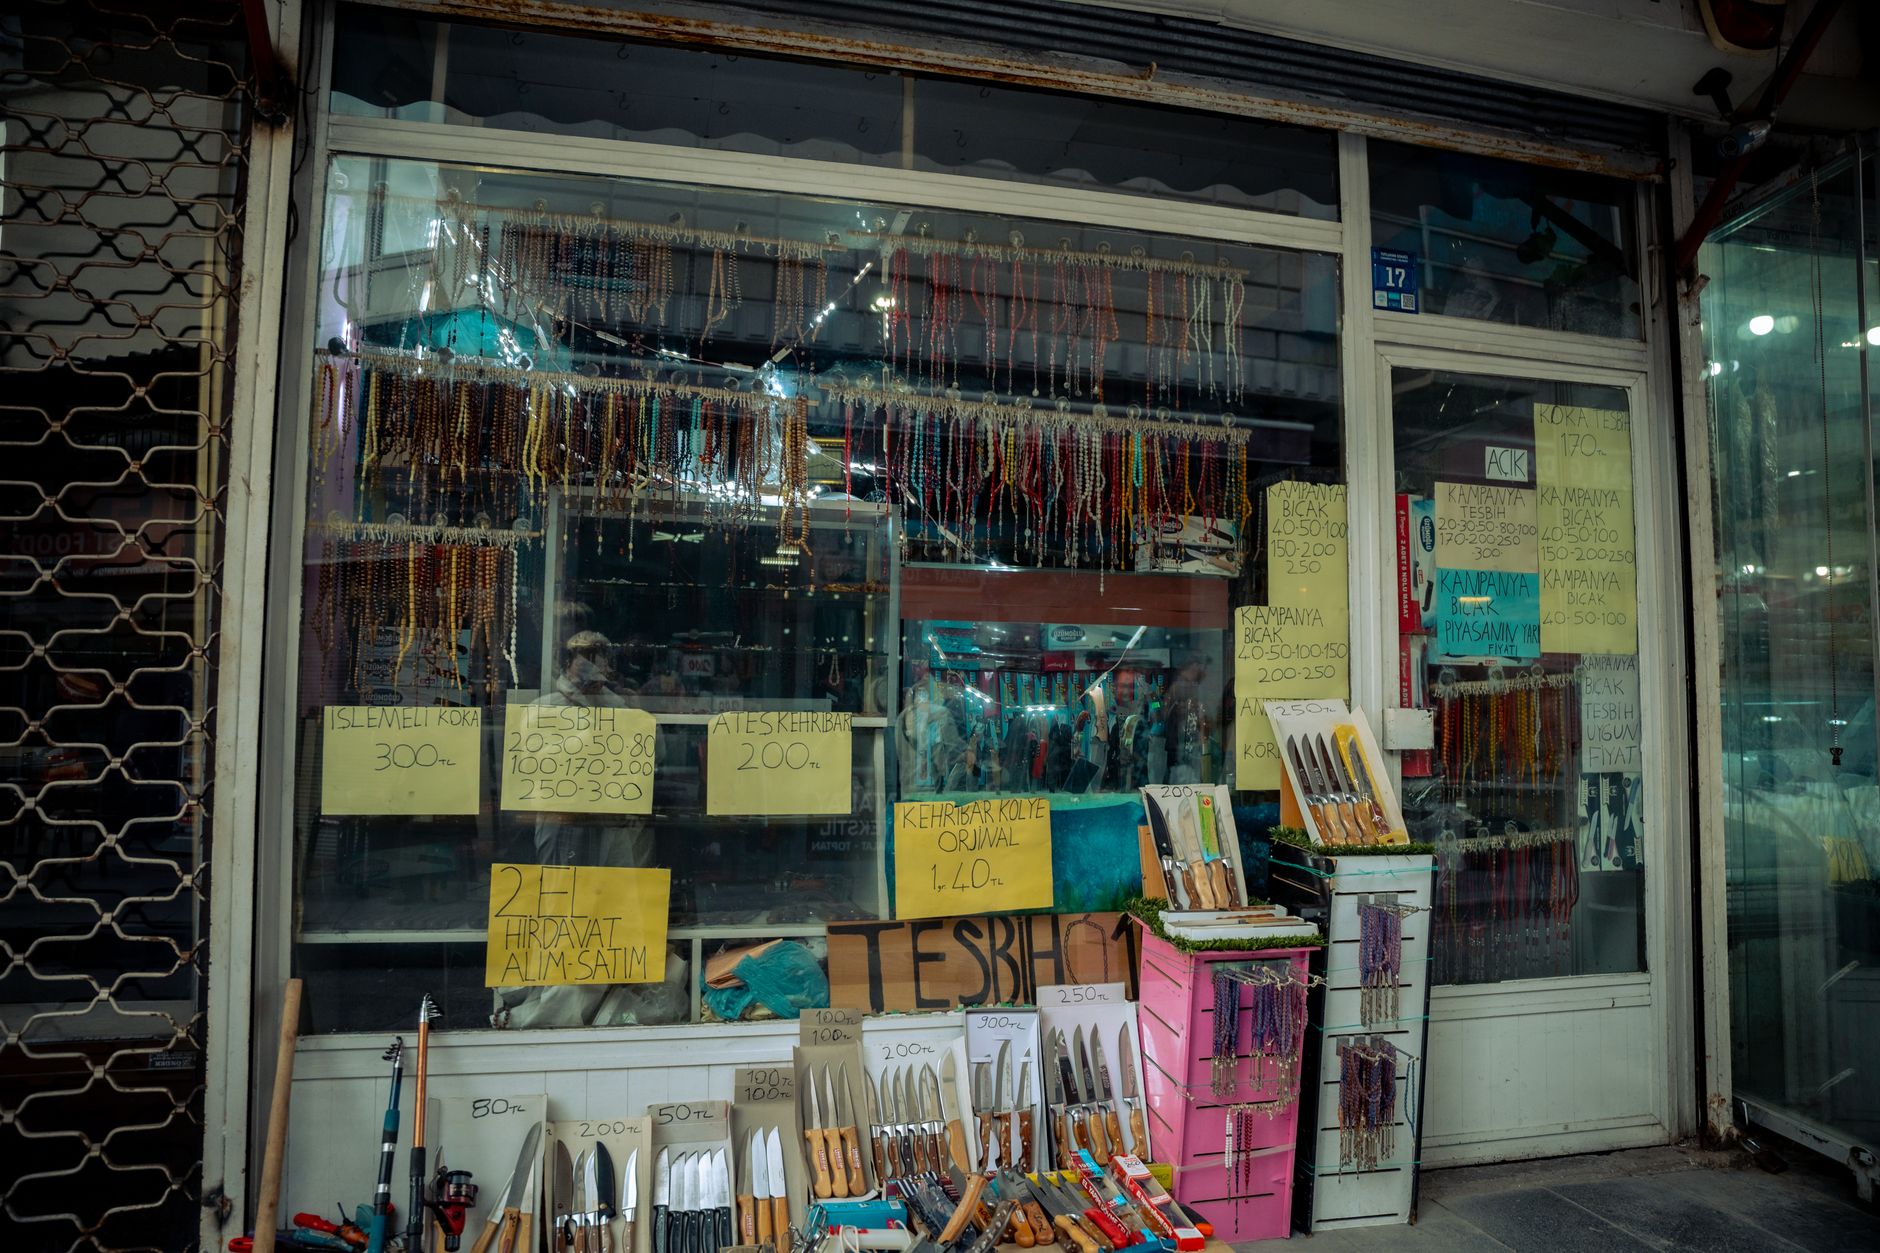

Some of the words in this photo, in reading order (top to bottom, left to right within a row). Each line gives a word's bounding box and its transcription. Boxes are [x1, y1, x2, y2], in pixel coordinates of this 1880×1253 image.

[1386, 267, 1406, 288] 17
[1540, 404, 1588, 428] KOKA
[1487, 449, 1525, 477] AÇIK
[1268, 481, 1345, 502] KAMPANYA
[1448, 485, 1526, 507] KAMPANYA
[1540, 487, 1620, 509] KAMPANYA
[1287, 560, 1321, 574] 250
[1440, 571, 1530, 597] KAMPANYA
[1543, 568, 1621, 592] KAMPANYA
[1240, 606, 1324, 627] KAMPANYA
[1258, 665, 1336, 683] 200-250
[1581, 656, 1636, 672] KAMPANYA
[438, 710, 479, 727] KOKA
[1587, 723, 1639, 742] UYGUN
[519, 779, 642, 802] 250-300
[999, 798, 1046, 823] KOLYE
[938, 826, 1019, 852] ORJİNAL
[506, 917, 622, 950] HIRDAVAT
[501, 945, 647, 982] ALIM-SATIM
